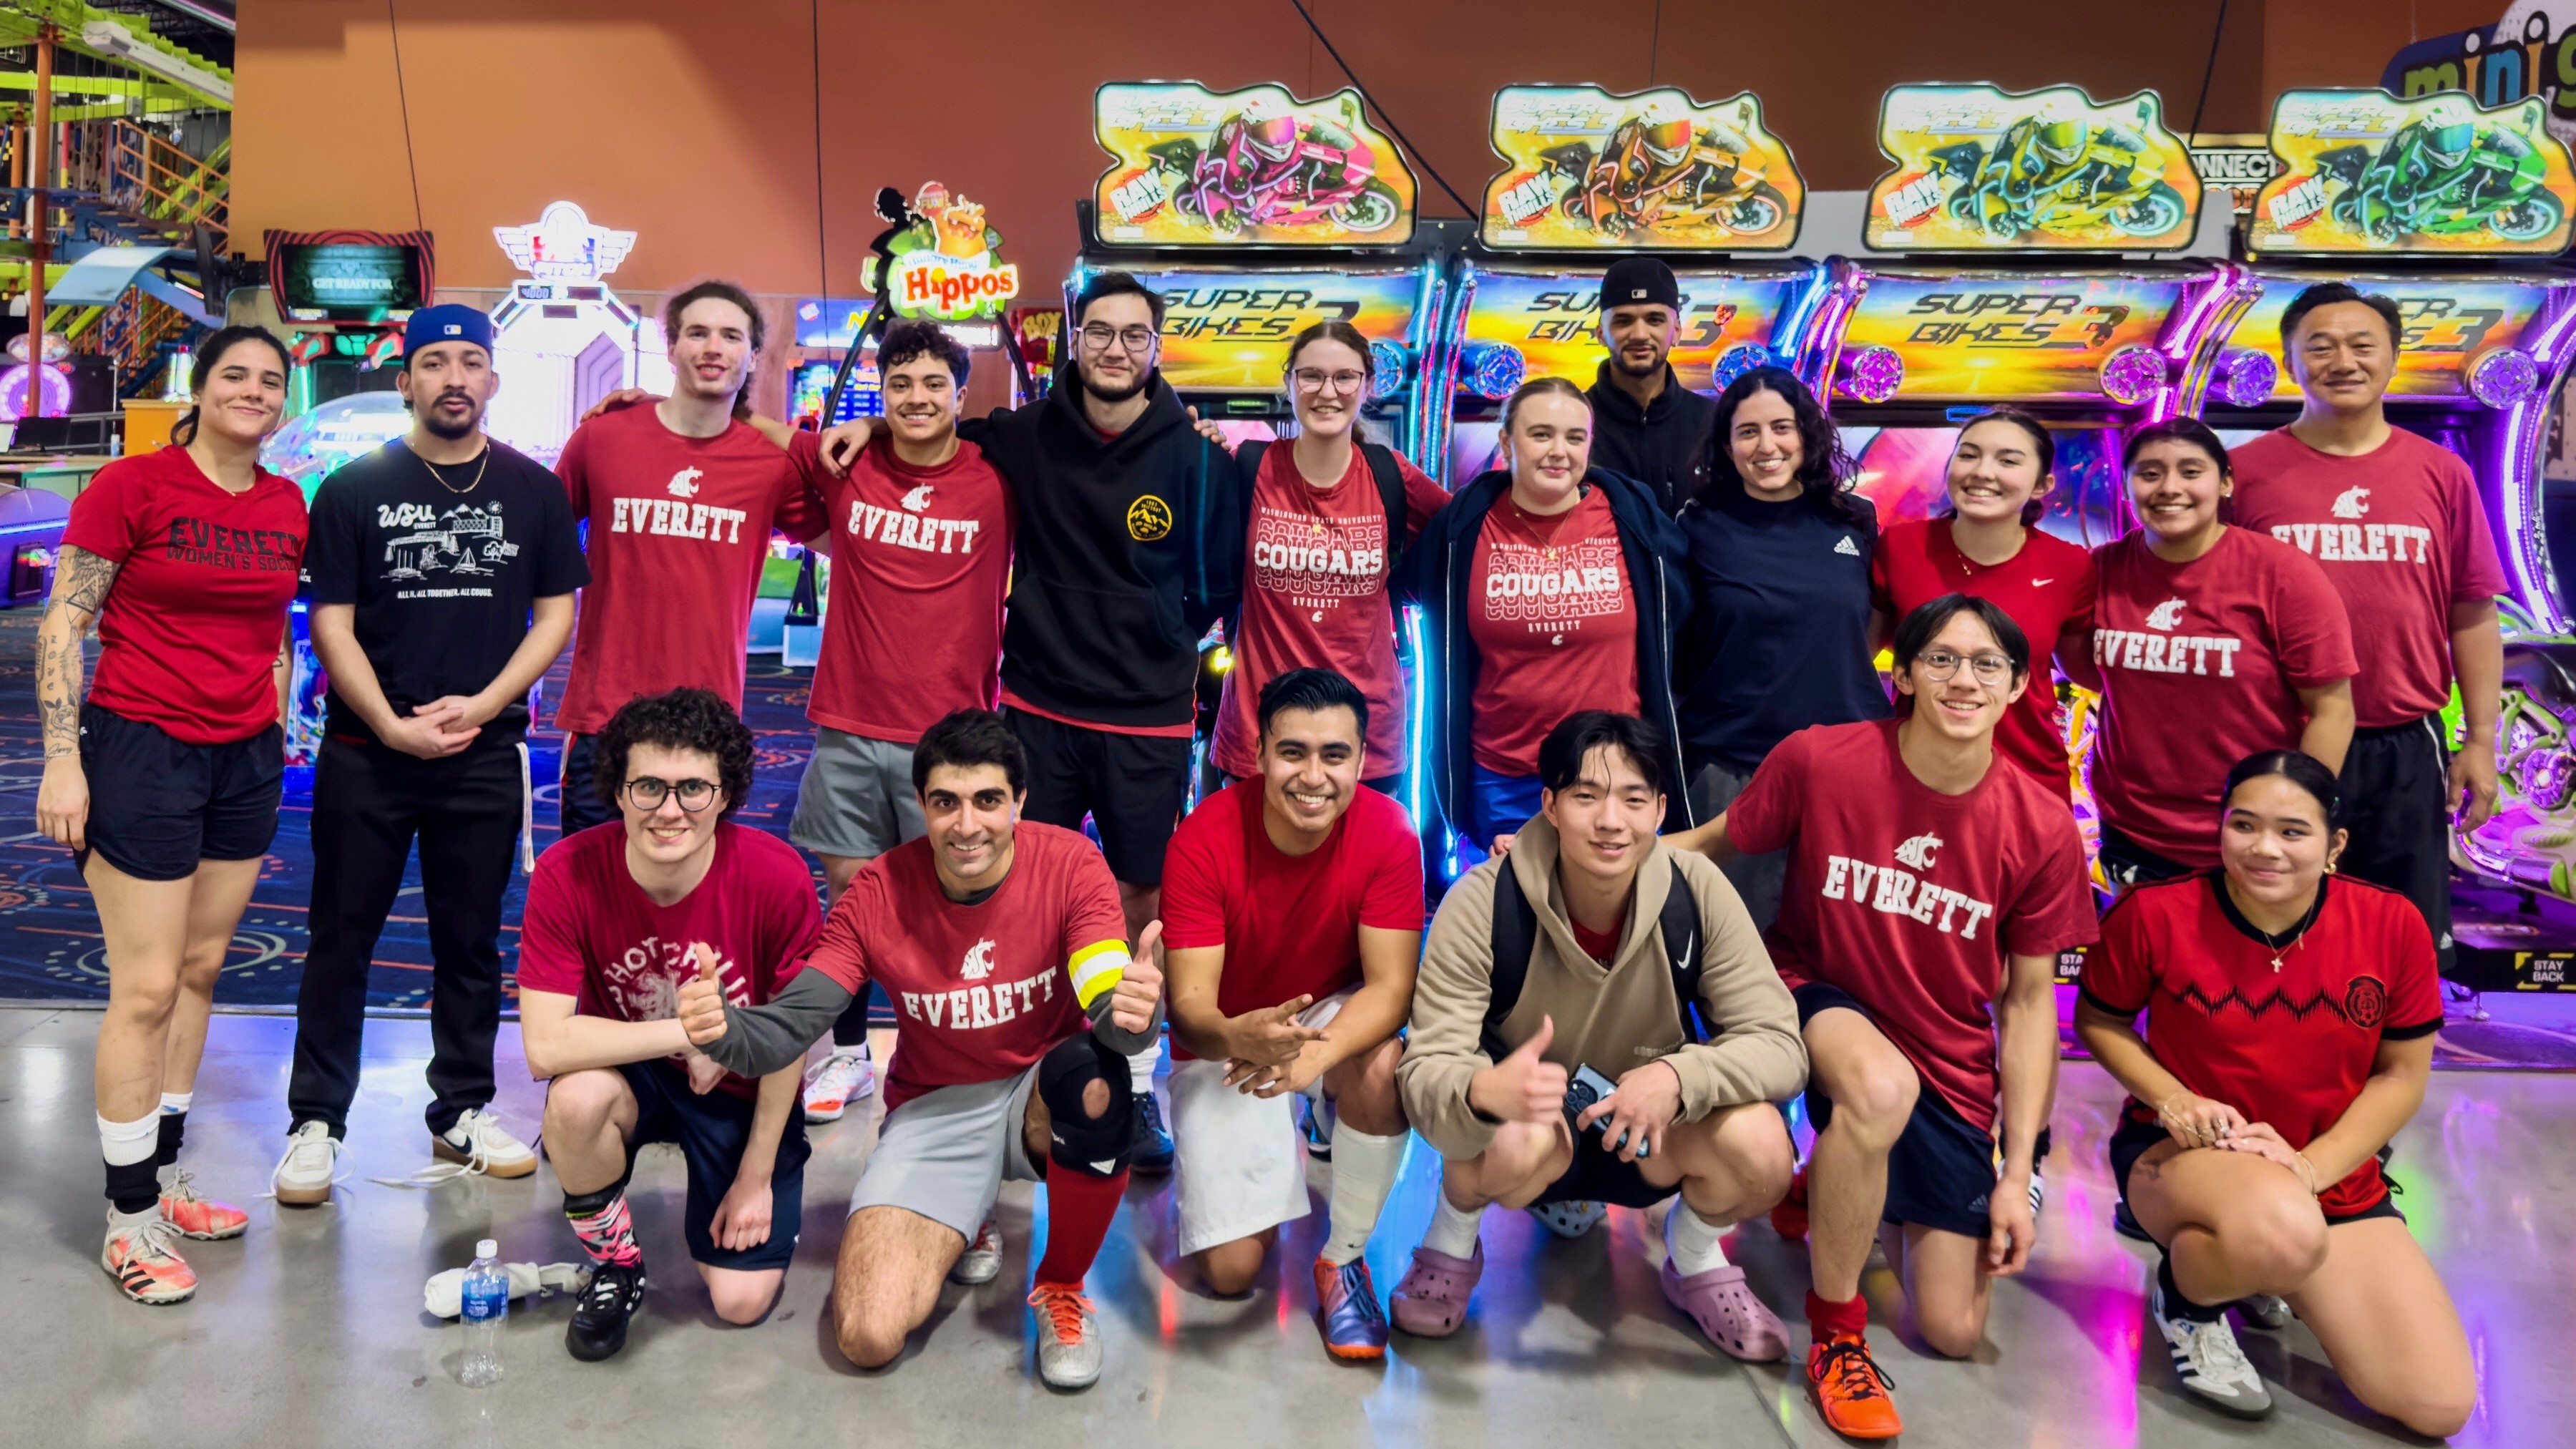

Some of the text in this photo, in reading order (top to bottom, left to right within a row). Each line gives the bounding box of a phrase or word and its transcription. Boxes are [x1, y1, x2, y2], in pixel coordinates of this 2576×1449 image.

[2192, 154, 2276, 178] NNECT
[1110, 166, 1162, 208] RAW
[1497, 170, 1551, 213] RAW
[1883, 170, 1939, 213] RAW
[2268, 174, 2323, 217] RAW
[1503, 188, 1557, 226] THRILLS
[2273, 193, 2328, 229] THRILLS
[313, 278, 393, 290] GET READY FOR
[905, 267, 1013, 311] Hippos
[1164, 289, 1313, 313] SUPER
[1908, 294, 2082, 318] SUPER
[1161, 317, 1297, 338] BIKES
[1906, 322, 2060, 345] BIKES
[377, 502, 436, 528] WSU
[613, 497, 746, 545] EVERETT
[849, 500, 978, 554] EVERETT
[1261, 507, 1382, 525] WASHINGTON STATE UNIVERSITY
[169, 516, 298, 557] EVERETT
[2271, 523, 2431, 565] EVERETT
[166, 546, 251, 570] WOMEN'S
[1254, 541, 1383, 575] COUGARS
[1486, 566, 1620, 598] COUGARS
[1293, 597, 1340, 608] EVERETT
[1528, 620, 1580, 633] EVERETT
[2093, 629, 2240, 677] EVERETT
[1822, 855, 1993, 940] EVERETT
[2061, 954, 2084, 965] STA
[2534, 960, 2565, 971] STAY
[2533, 971, 2565, 982] BACK
[901, 966, 1059, 1030] EVERETT
